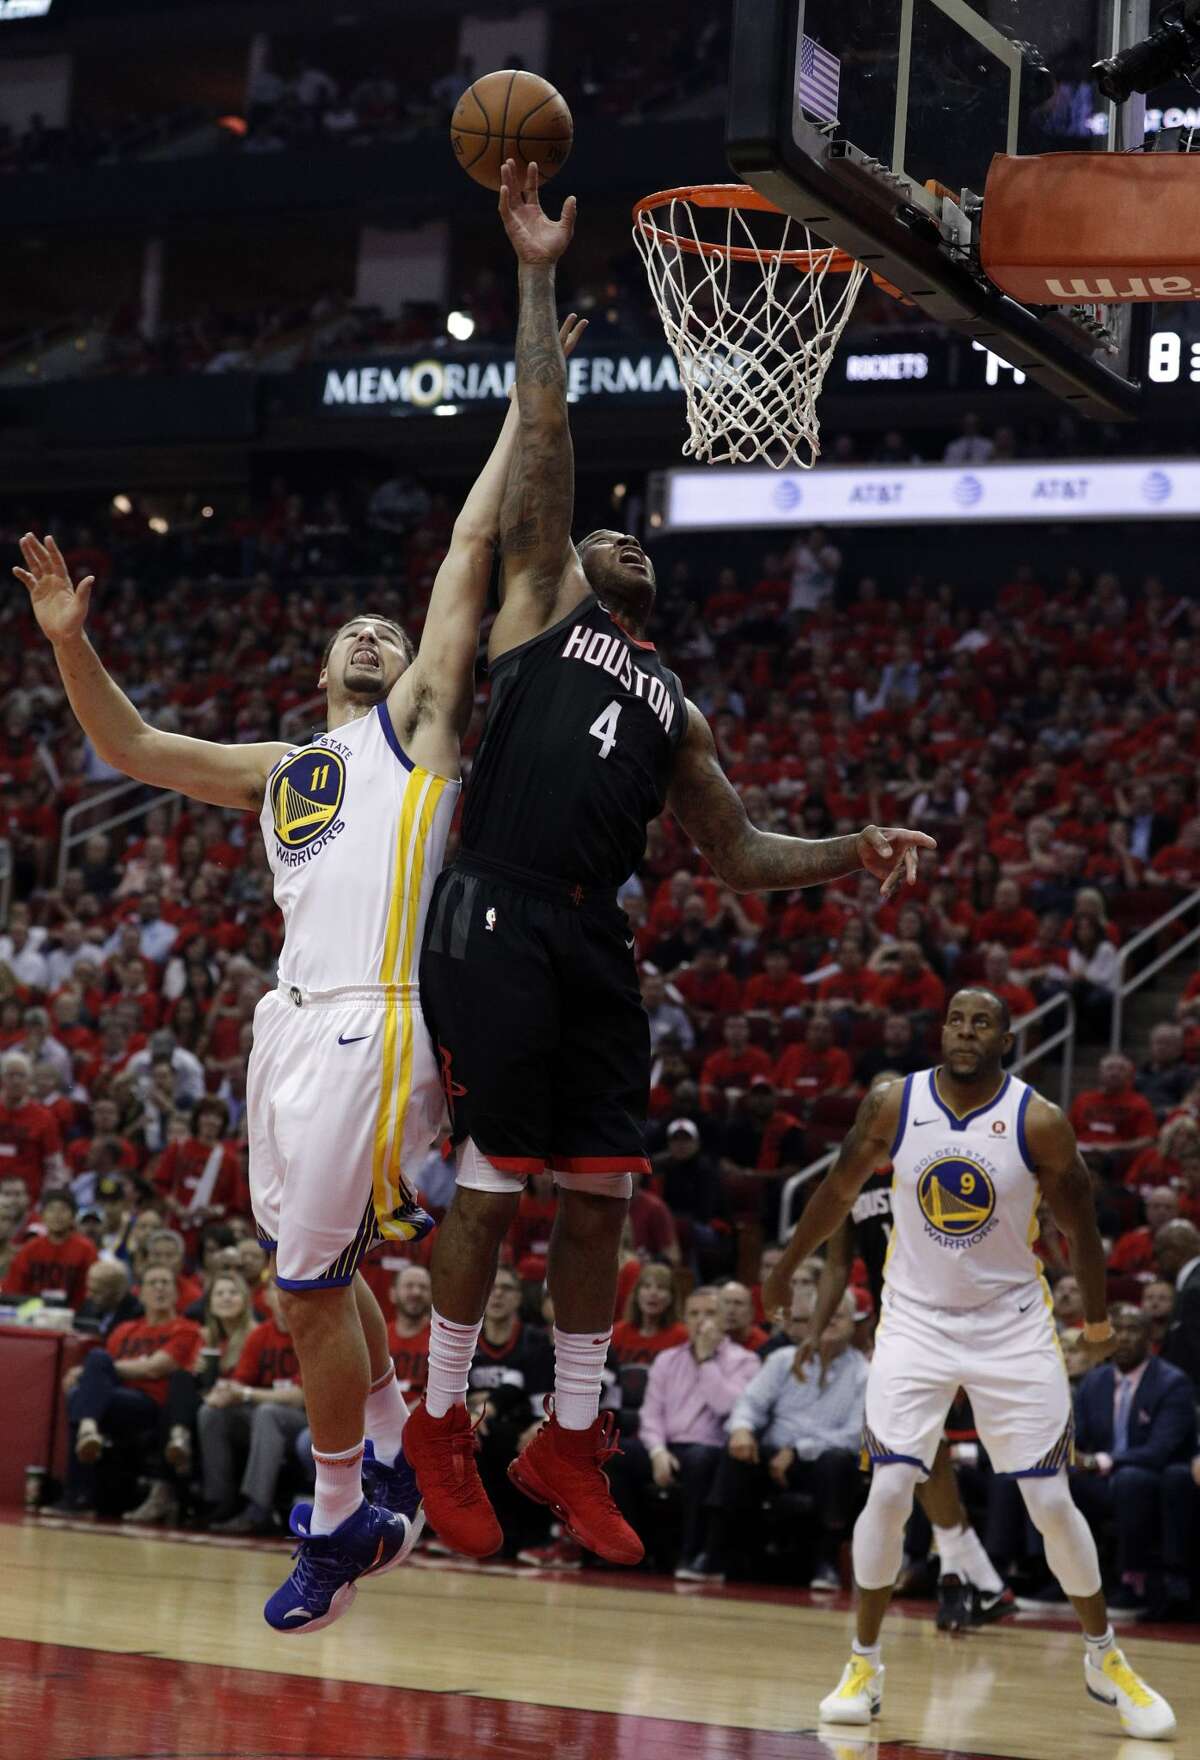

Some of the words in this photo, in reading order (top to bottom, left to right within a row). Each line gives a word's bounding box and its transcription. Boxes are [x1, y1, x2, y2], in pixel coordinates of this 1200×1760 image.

[1045, 276, 1200, 298] arm
[850, 483, 906, 506] AT&T
[1032, 479, 1091, 502] AT&T
[561, 625, 676, 734] HOUSTON
[588, 700, 623, 759] 4
[320, 737, 353, 761] STATE
[310, 764, 330, 792] 11
[276, 819, 346, 868] WARRIORS
[913, 1147, 961, 1174] GOLDEN
[965, 1149, 999, 1175] STATE
[959, 1172, 976, 1195] 9
[924, 1217, 1000, 1250] WARRIORS
